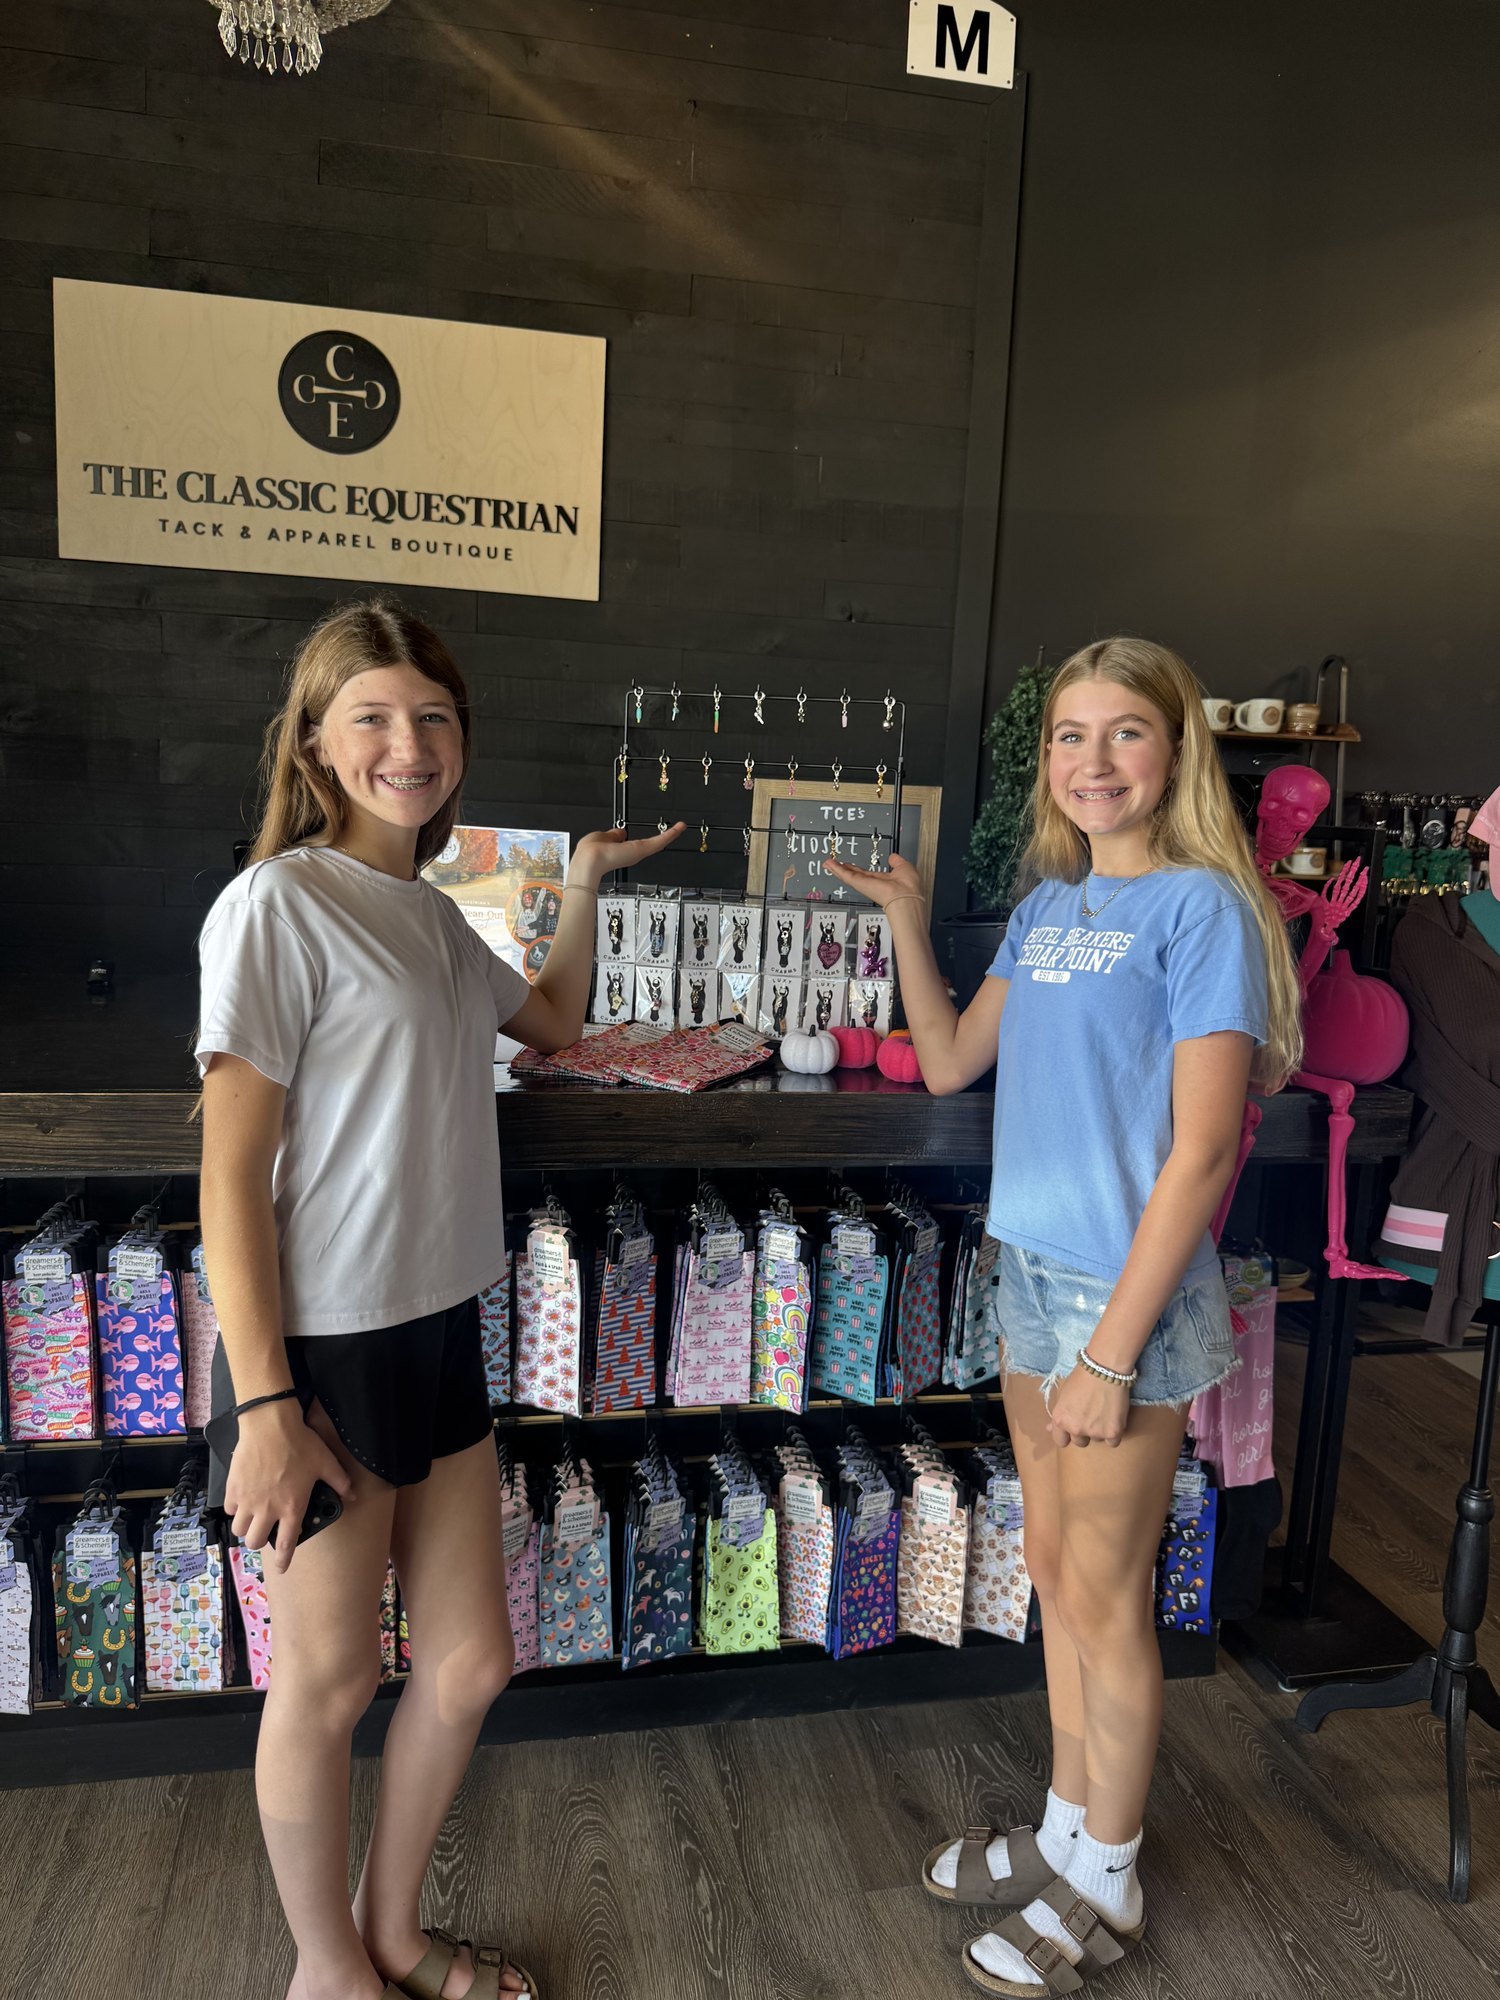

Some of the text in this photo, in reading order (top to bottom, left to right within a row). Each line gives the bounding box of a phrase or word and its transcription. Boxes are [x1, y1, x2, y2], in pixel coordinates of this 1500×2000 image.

[936, 4, 990, 74] M
[82, 463, 580, 536] THE CLASSIC EQUESTRIAN
[158, 518, 515, 561] TACK & APPAREL BOUTIQUE
[820, 806, 866, 821] TCE's
[463, 908, 504, 921] lean Out
[1059, 946, 1127, 974] POINT
[118, 1254, 150, 1262] dreamers
[1232, 1418, 1270, 1445] horse
[1237, 1438, 1264, 1478] girl
[563, 1510, 588, 1518] dreamers
[568, 1514, 592, 1523] schemers
[164, 1532, 194, 1540] dreamers
[861, 1554, 883, 1565] LUCKY
[885, 1615, 892, 1627] 7
